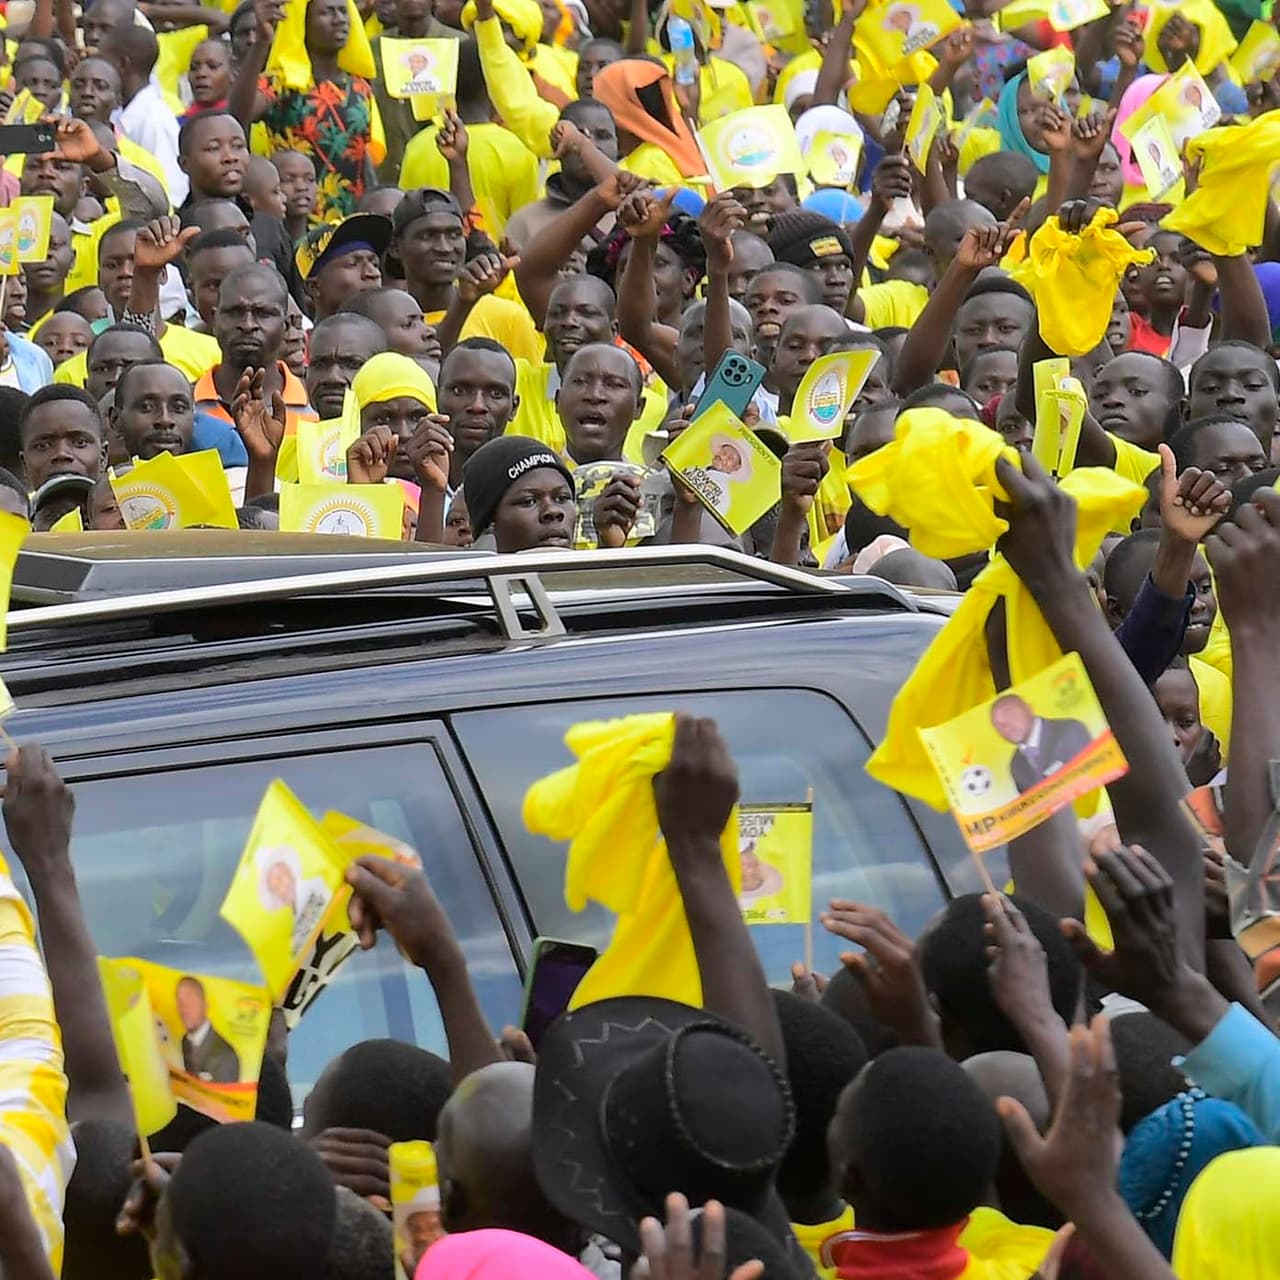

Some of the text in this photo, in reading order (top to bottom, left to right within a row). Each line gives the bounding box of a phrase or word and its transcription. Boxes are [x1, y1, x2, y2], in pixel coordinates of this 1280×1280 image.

[508, 453, 556, 478] CHAMPION
[695, 465, 723, 496] YOWERI
[682, 467, 721, 506] MUSEVENI
